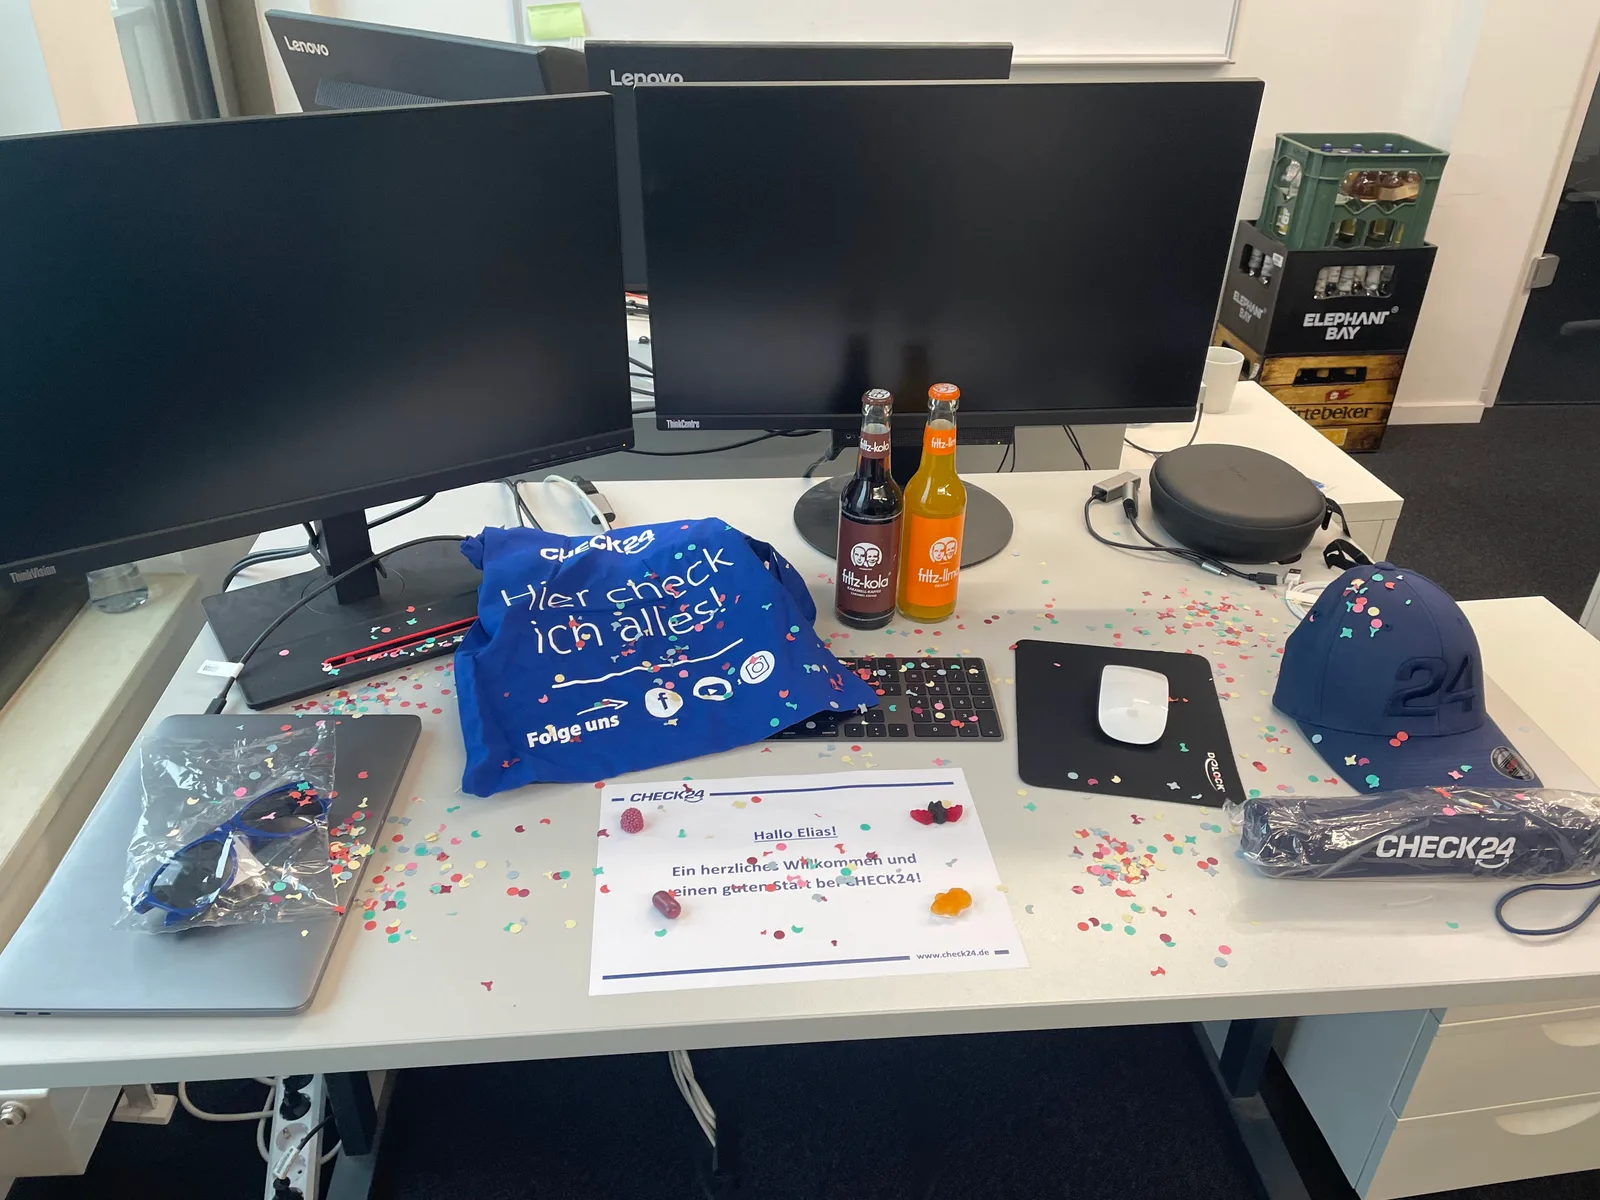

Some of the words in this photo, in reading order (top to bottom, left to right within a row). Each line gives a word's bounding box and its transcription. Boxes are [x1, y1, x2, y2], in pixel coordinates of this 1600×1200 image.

[283, 35, 330, 57] Lenovo
[610, 69, 684, 86] Lenovo
[1232, 290, 1264, 320] ELEPHANT
[1238, 307, 1253, 324] BAY
[1303, 311, 1390, 327] ELEPHANT
[1325, 326, 1361, 341] BAY
[666, 419, 700, 429] ThinkCentre
[9, 565, 57, 583] ThinkVision
[500, 580, 590, 611] Hier
[606, 547, 735, 604] check
[841, 568, 889, 589] fritz-kola
[530, 614, 604, 655] ich
[617, 586, 727, 643] alles!
[1383, 654, 1476, 718] 24
[526, 723, 582, 749] Folge
[584, 714, 620, 733] uns
[629, 789, 705, 802] CHECK24
[753, 829, 793, 841] Hallo
[797, 825, 837, 838] Elias!
[1376, 835, 1516, 862] CHECK24
[672, 865, 696, 877] Ein
[887, 852, 917, 866] und
[674, 885, 718, 897] einen
[722, 884, 769, 897] guten
[772, 879, 812, 892] Stat
[816, 877, 841, 889] be
[916, 949, 990, 960] www.check24.de
